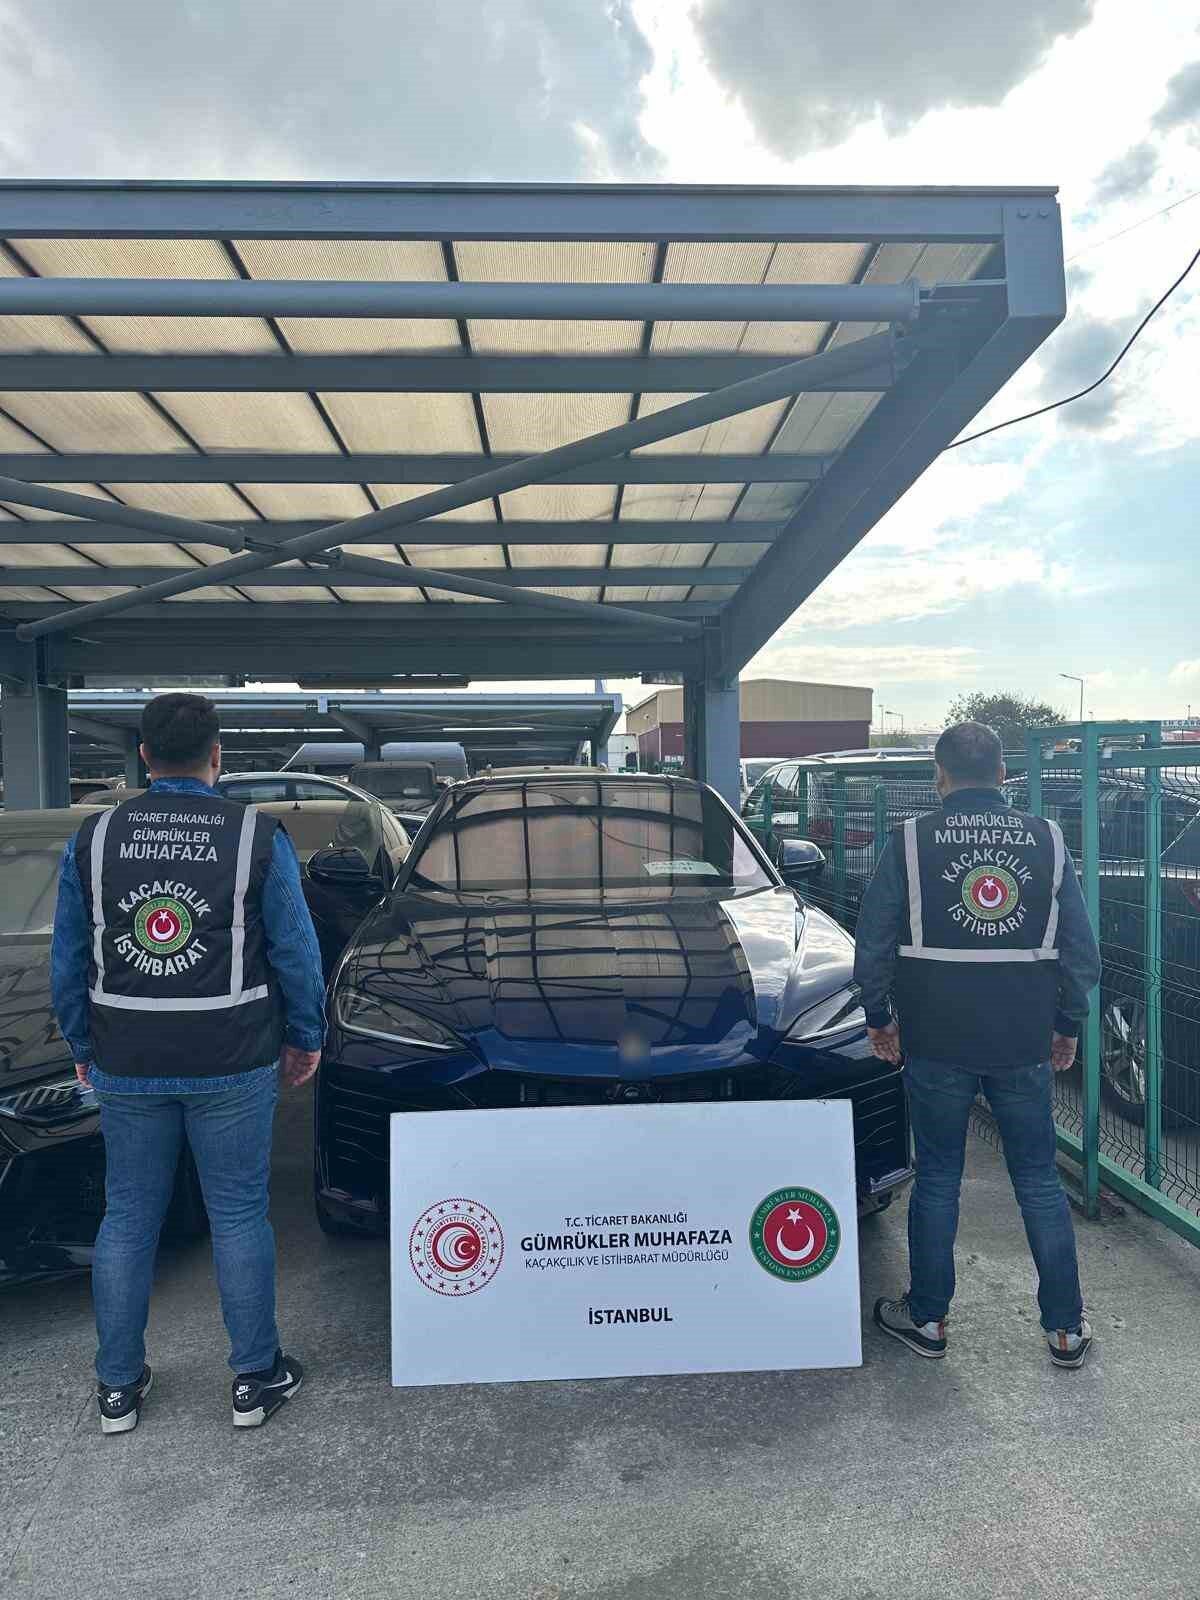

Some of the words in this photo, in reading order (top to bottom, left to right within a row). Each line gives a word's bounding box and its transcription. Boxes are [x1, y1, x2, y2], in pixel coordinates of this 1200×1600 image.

[127, 811, 168, 823] TİCARET
[170, 813, 225, 826] BAKANLIĞI
[946, 811, 1024, 829] GÜMRÜKLER
[132, 827, 210, 843] GÜMRÜKLER
[935, 829, 1037, 846] MUHAFAZA
[119, 843, 218, 862] MUHAFAZA
[941, 848, 1033, 885] KAÇAKÇILIK
[117, 879, 212, 918] KAÇAKÇILIK
[947, 902, 1028, 937] İSTİHBARAT
[113, 932, 208, 976] İSTİHBARAT
[564, 1217, 584, 1227] T.C.
[585, 1214, 629, 1227] TİCARET
[630, 1211, 688, 1225] BAKANLIĞI
[520, 1231, 630, 1251] GÜMRÜKLER
[634, 1229, 733, 1247] MUHAFAZA
[525, 1255, 585, 1270] KAÇAKÇILIK
[586, 1255, 599, 1266] VE
[601, 1252, 660, 1266] İSTİHBARAT
[661, 1248, 729, 1263] MÜDÜRLÜĞÜ
[588, 1307, 673, 1325] İSTANBUL
